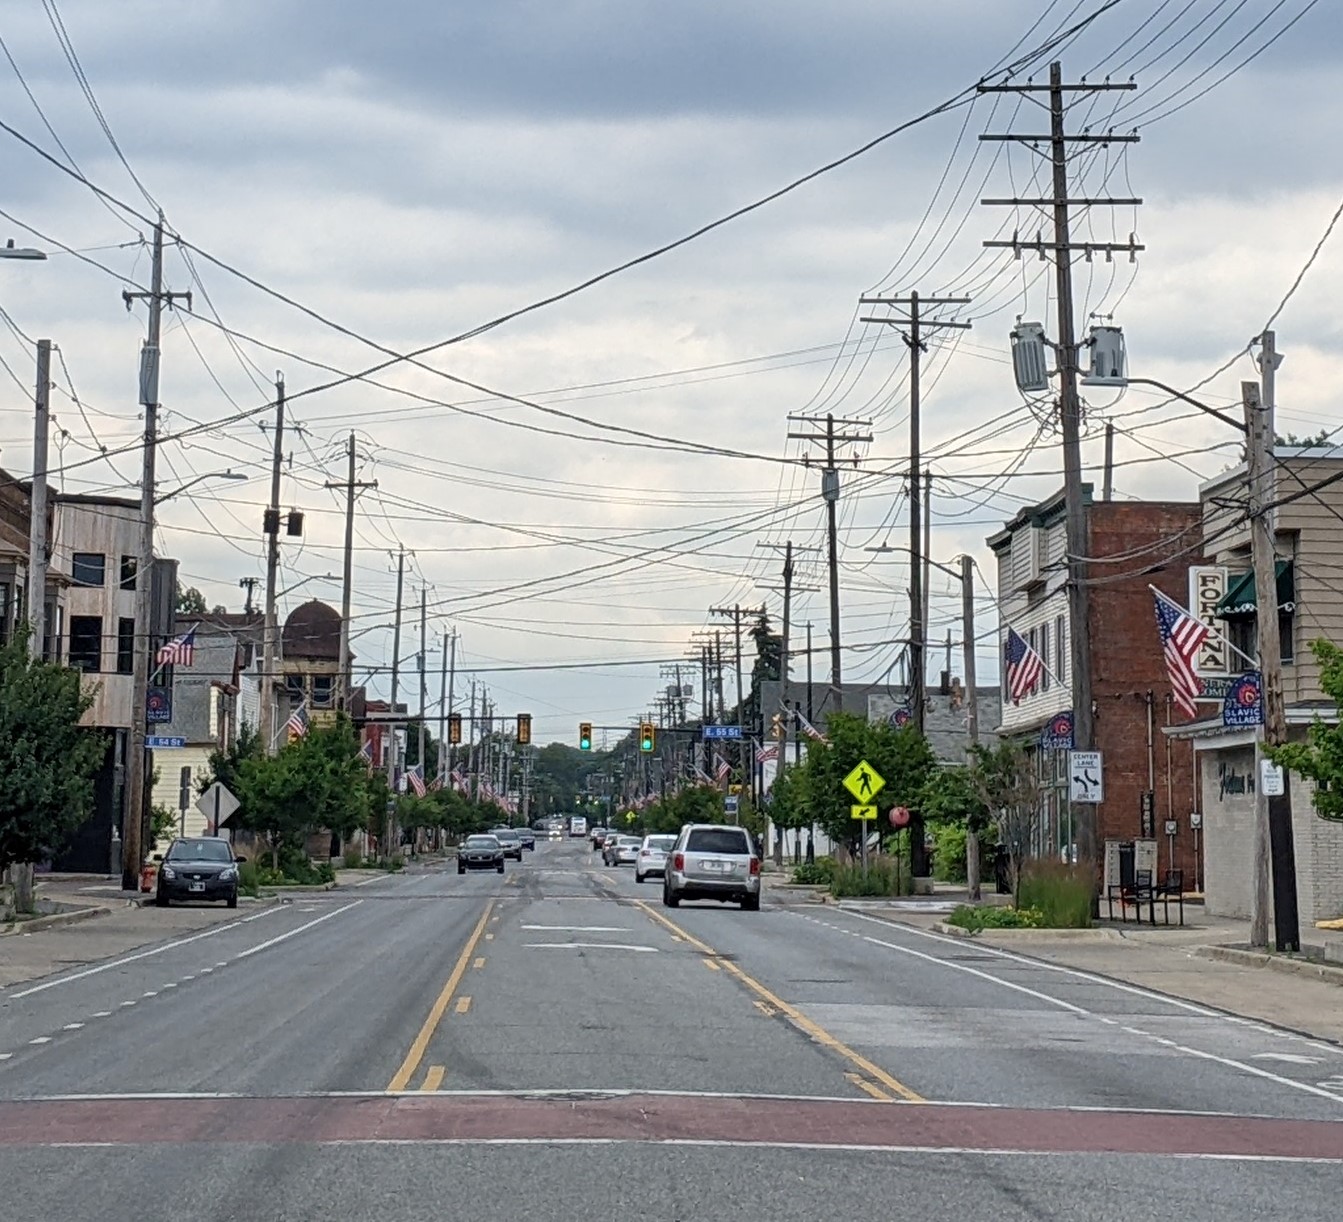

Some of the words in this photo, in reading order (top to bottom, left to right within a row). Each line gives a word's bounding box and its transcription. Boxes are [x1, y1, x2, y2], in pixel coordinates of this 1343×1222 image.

[1225, 708, 1260, 717] SLAVIC
[1225, 716, 1261, 725] VILLAGE
[170, 738, 181, 746] St
